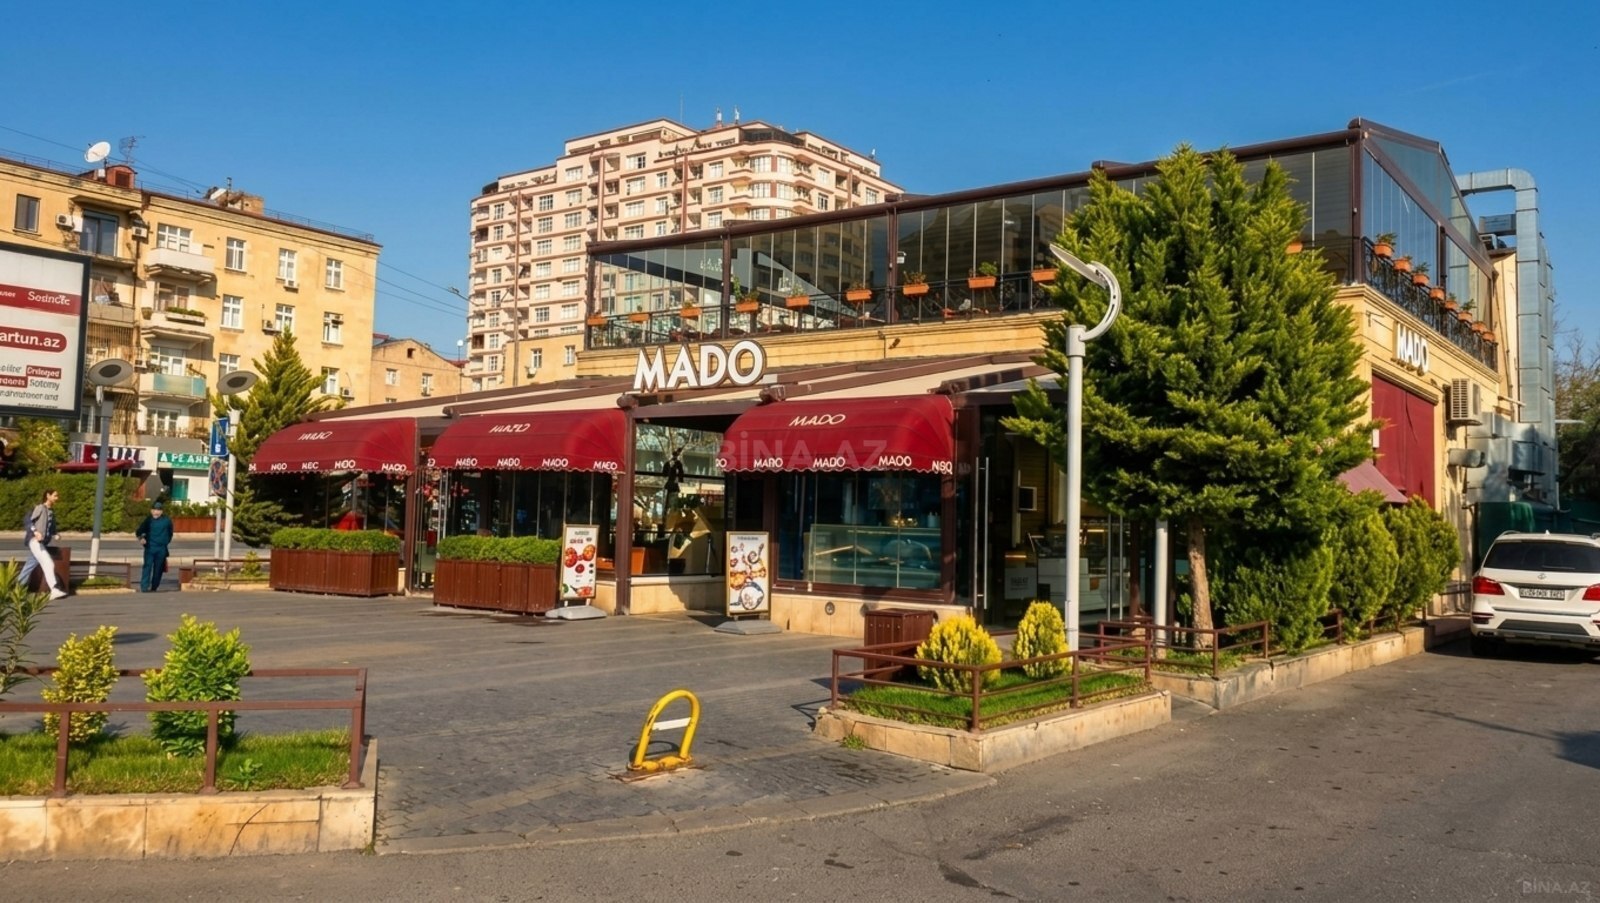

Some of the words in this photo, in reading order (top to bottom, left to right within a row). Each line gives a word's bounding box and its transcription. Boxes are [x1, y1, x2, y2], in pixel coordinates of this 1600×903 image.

[1396, 323, 1429, 373] MADO
[633, 339, 764, 390] MADO
[789, 414, 846, 426] MADO
[813, 456, 846, 468] MADO
